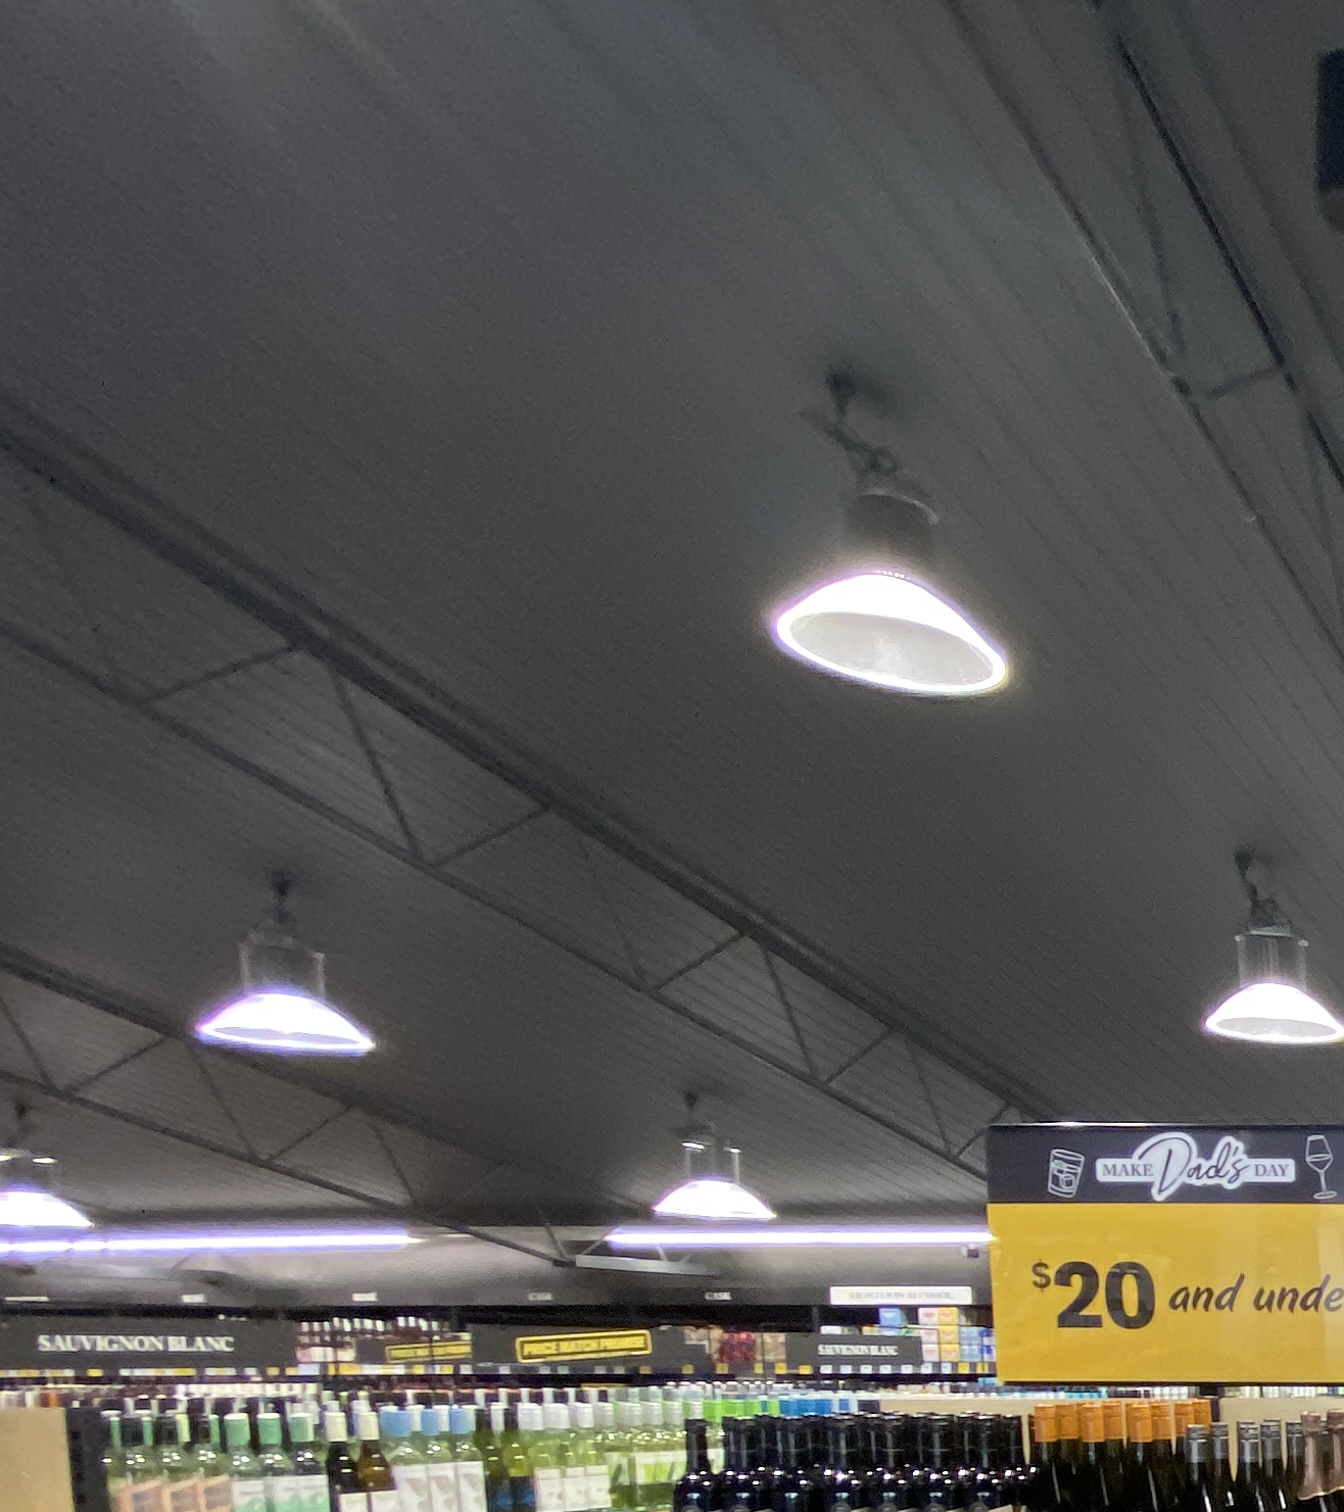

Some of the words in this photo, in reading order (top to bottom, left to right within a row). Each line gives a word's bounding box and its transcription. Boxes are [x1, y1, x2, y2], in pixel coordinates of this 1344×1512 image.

[1102, 1163, 1154, 1177] MAKE
[1138, 1136, 1249, 1193] Dad's
[1254, 1163, 1290, 1178] DAY
[1032, 1260, 1155, 1330] $20
[1169, 1273, 1245, 1312] and
[37, 1334, 164, 1351] SAUVIGNON
[167, 1336, 235, 1352] BLANC
